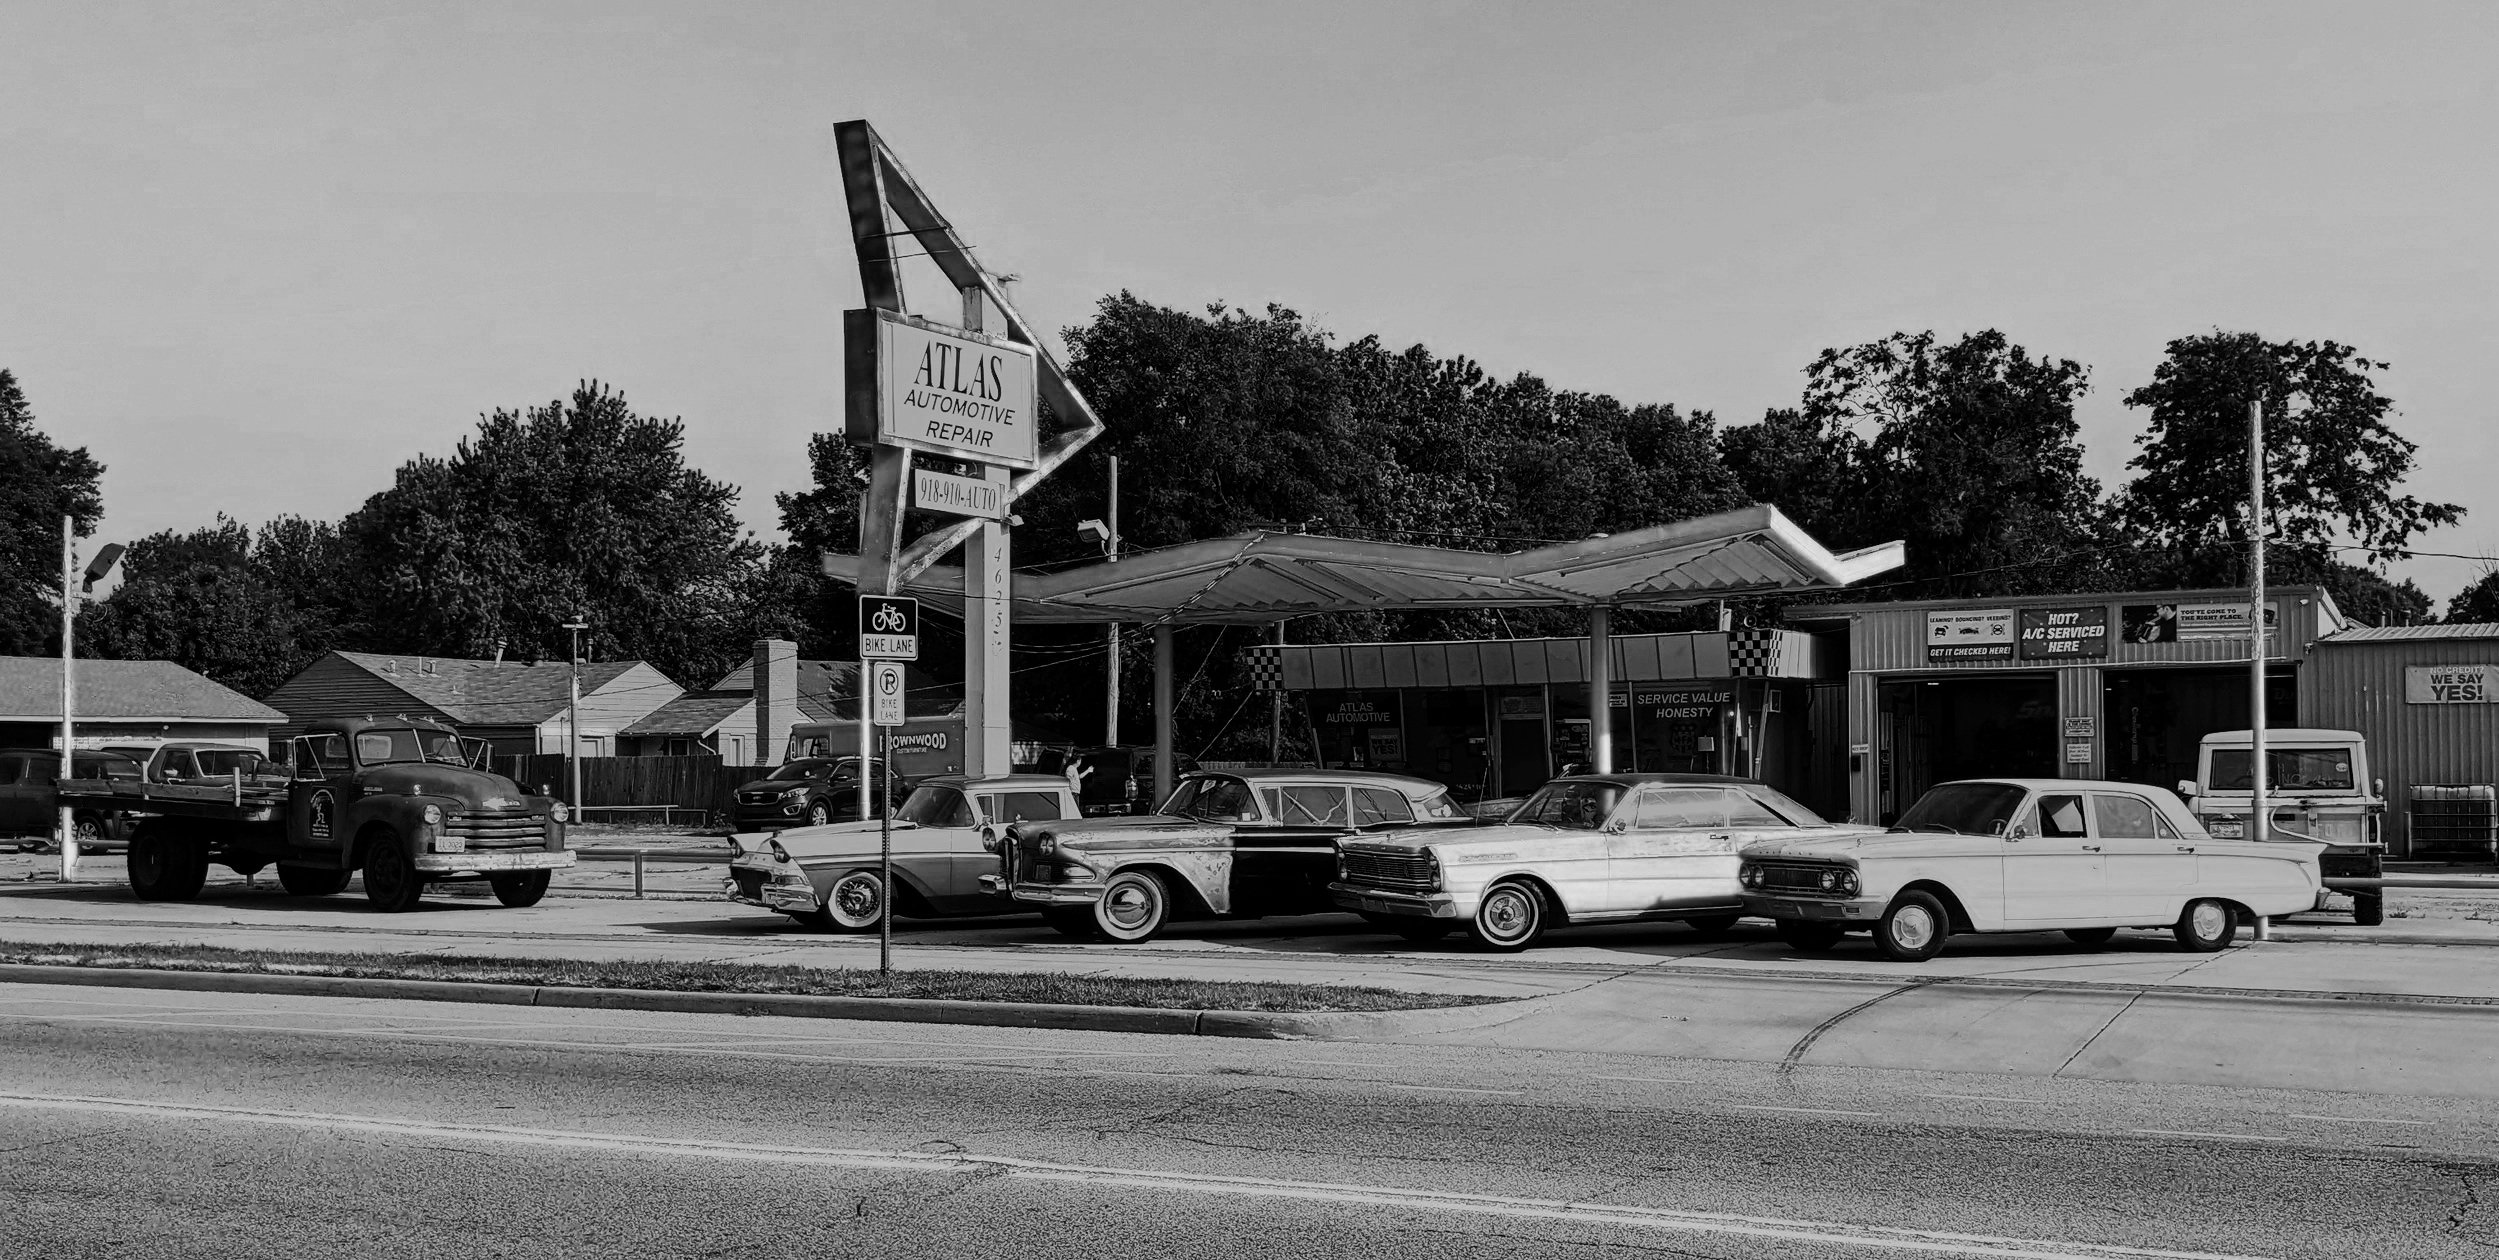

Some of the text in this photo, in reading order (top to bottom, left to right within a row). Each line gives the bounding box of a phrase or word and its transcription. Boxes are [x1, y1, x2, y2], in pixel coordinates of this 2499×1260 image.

[914, 339, 1003, 402] ATLAS
[904, 389, 1016, 426] AUTOMOTIVE
[926, 420, 994, 447] REPAIR
[921, 477, 996, 511] 918-910-AUTO
[2048, 612, 2080, 625] HOT?
[2022, 625, 2105, 640] A/C SERVICED
[865, 638, 913, 654] BIKE LANE
[1930, 646, 2011, 657] GET IT CHECKED HERE!
[2048, 640, 2080, 653] HERE
[2446, 666, 2484, 674] CREDIT?
[2431, 673, 2484, 684] WE SAY
[1637, 693, 1689, 705] SERVICE
[1692, 692, 1731, 703] VALUE
[2431, 684, 2483, 701] YES!
[881, 698, 897, 709] BIKE
[1339, 702, 1374, 713] ATLAS
[880, 711, 898, 721] LANE
[1326, 712, 1391, 723] AUTOMOTIVE
[1656, 707, 1714, 719] HONESTY
[879, 732, 947, 753] ROWNWOOD
